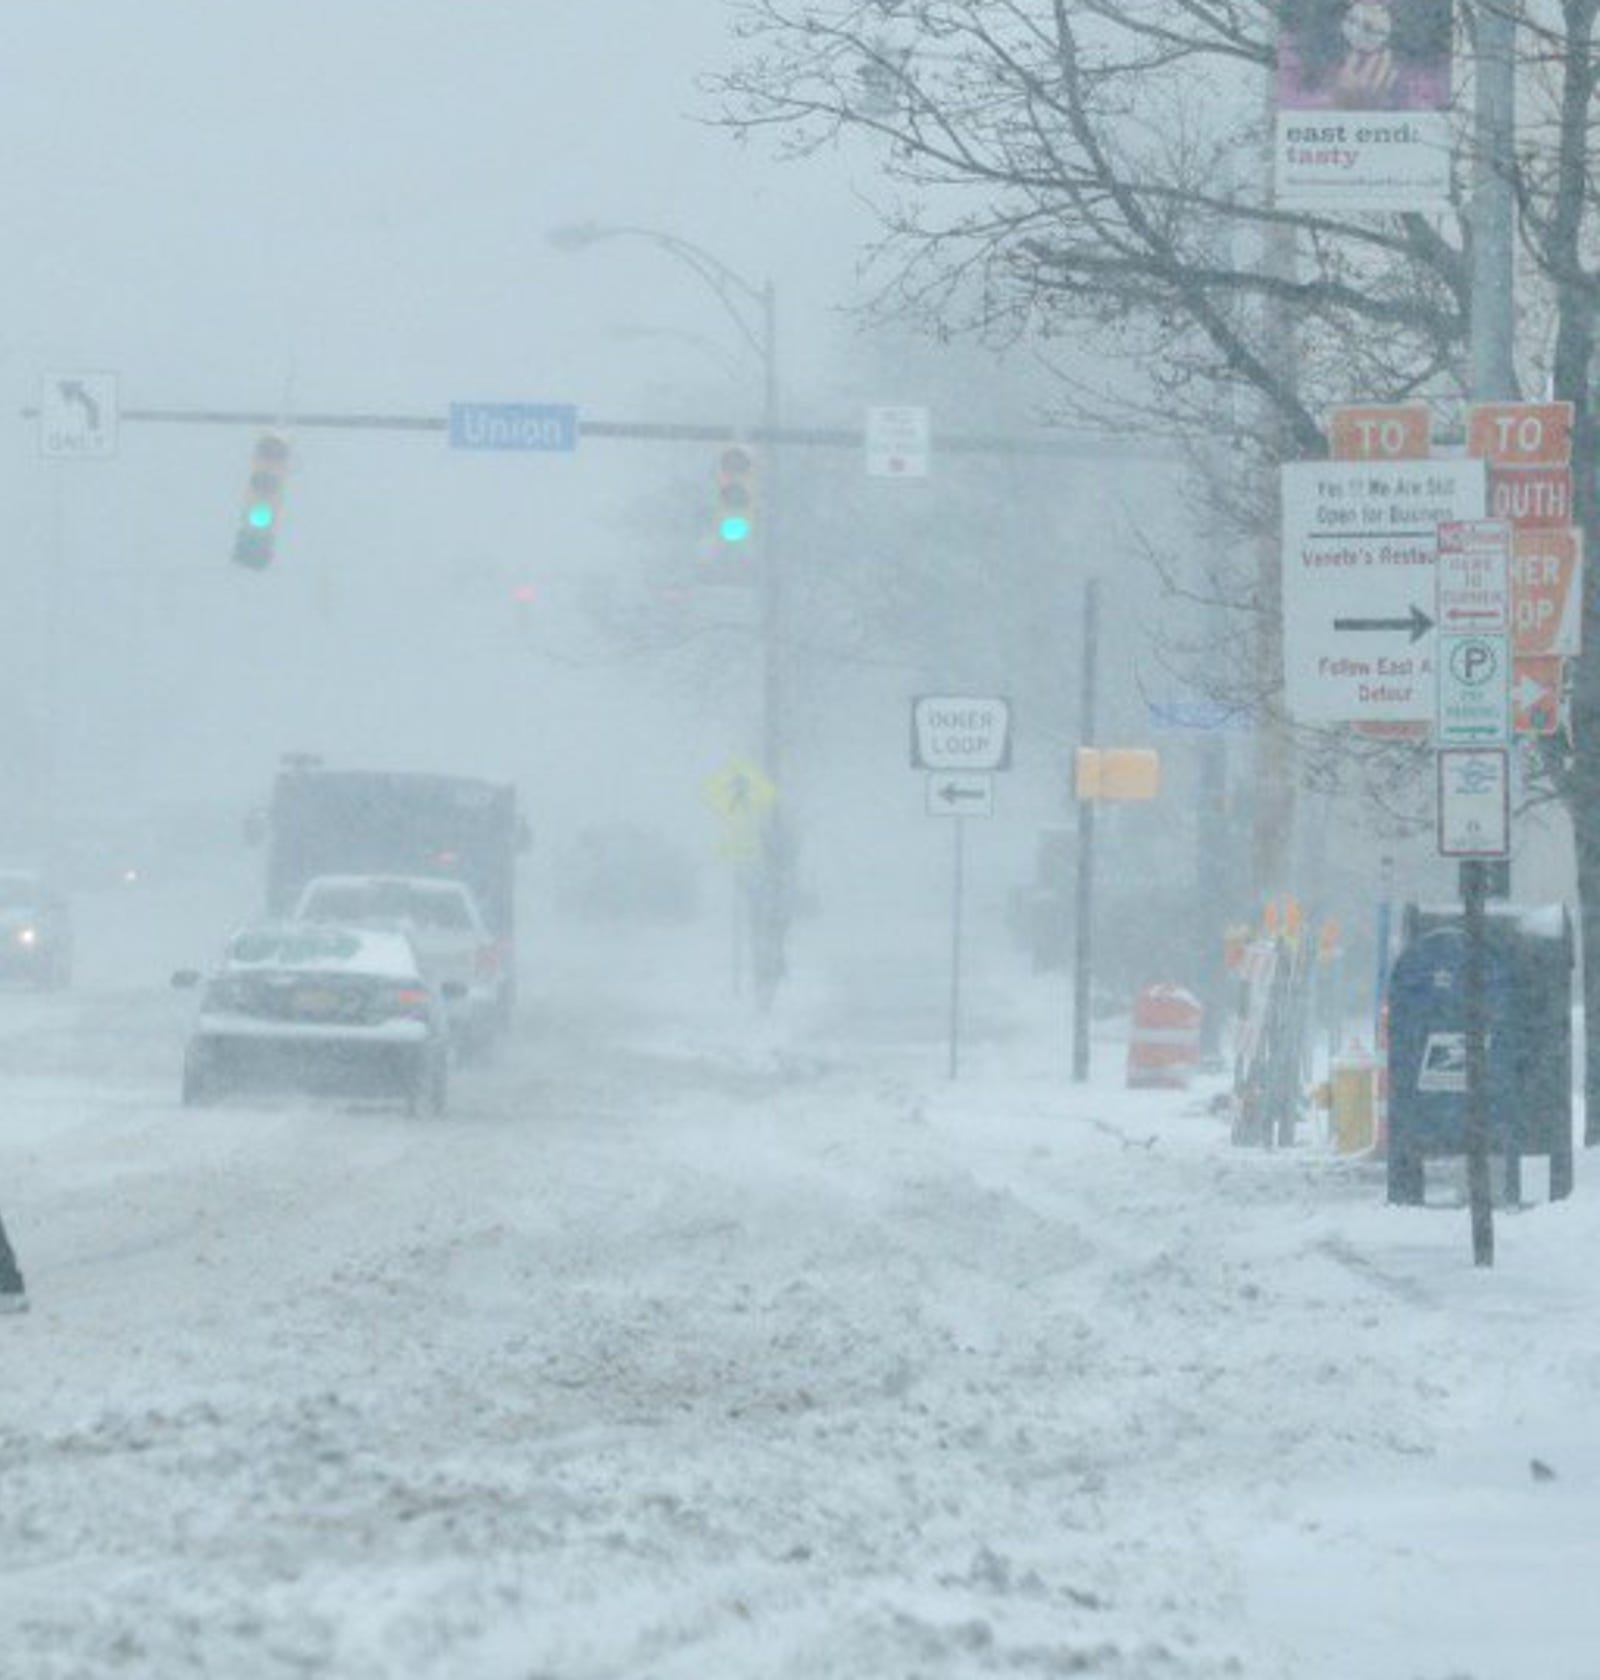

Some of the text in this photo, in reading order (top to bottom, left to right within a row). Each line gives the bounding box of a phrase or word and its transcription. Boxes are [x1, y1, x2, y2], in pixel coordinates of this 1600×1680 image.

[1285, 122, 1419, 144] east end:
[1286, 147, 1360, 169] tasty
[464, 410, 563, 446] Union
[1354, 419, 1404, 451] TO
[1494, 417, 1543, 451] TO
[1317, 480, 1343, 497] Yes
[1396, 478, 1421, 496] Are
[1494, 481, 1567, 517] OUTH
[1316, 504, 1357, 525] Open
[1361, 504, 1383, 523] for
[1378, 547, 1435, 567] Restau
[1511, 554, 1561, 586] NER
[1514, 598, 1555, 631] OP
[1317, 657, 1370, 676] Follow
[1376, 657, 1413, 676] East
[1358, 684, 1412, 704] Detour
[931, 735, 991, 755] LOOP
